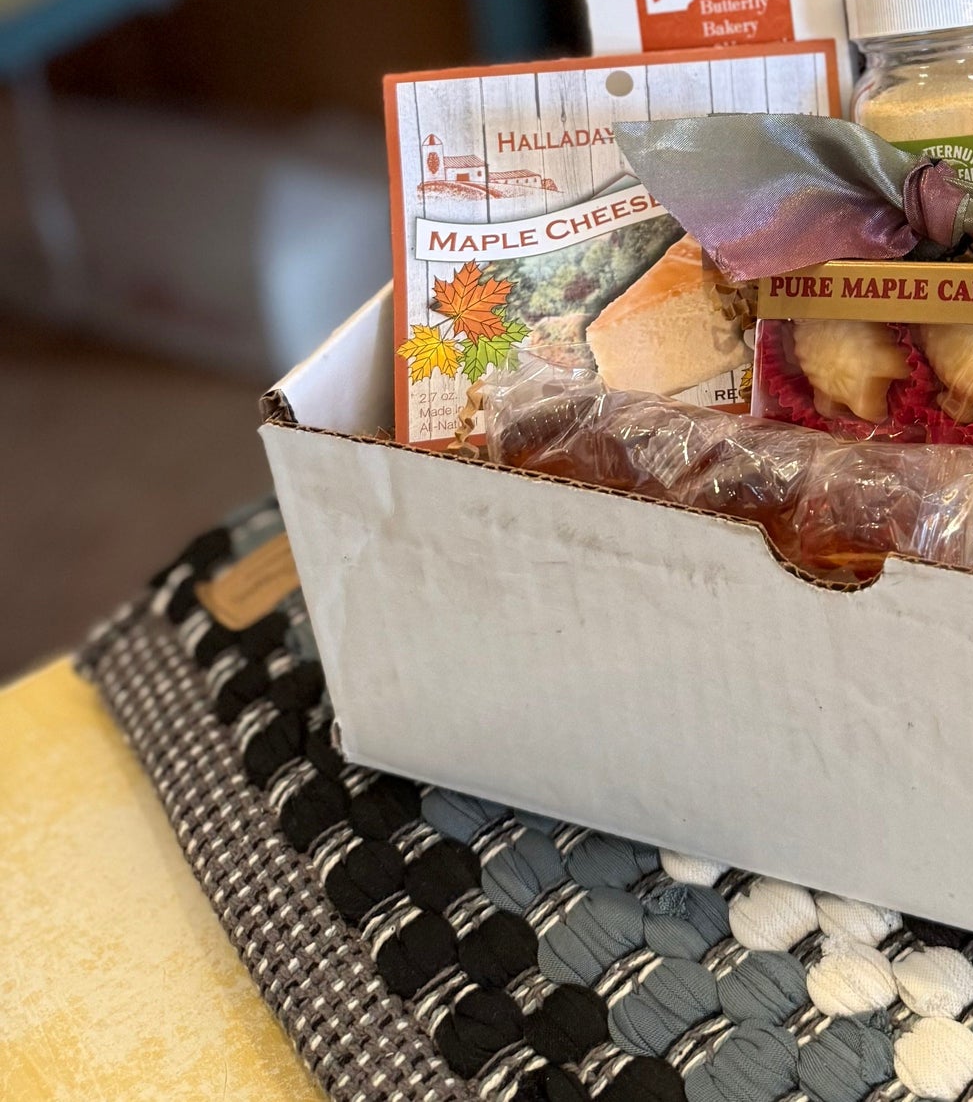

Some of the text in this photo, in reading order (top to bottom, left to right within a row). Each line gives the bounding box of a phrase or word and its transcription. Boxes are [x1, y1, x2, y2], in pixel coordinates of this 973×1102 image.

[703, 18, 759, 38] Bakery
[428, 229, 539, 253] MAPLE
[769, 276, 834, 298] PURE
[840, 277, 929, 300] MAPLE
[420, 406, 452, 419] Made
